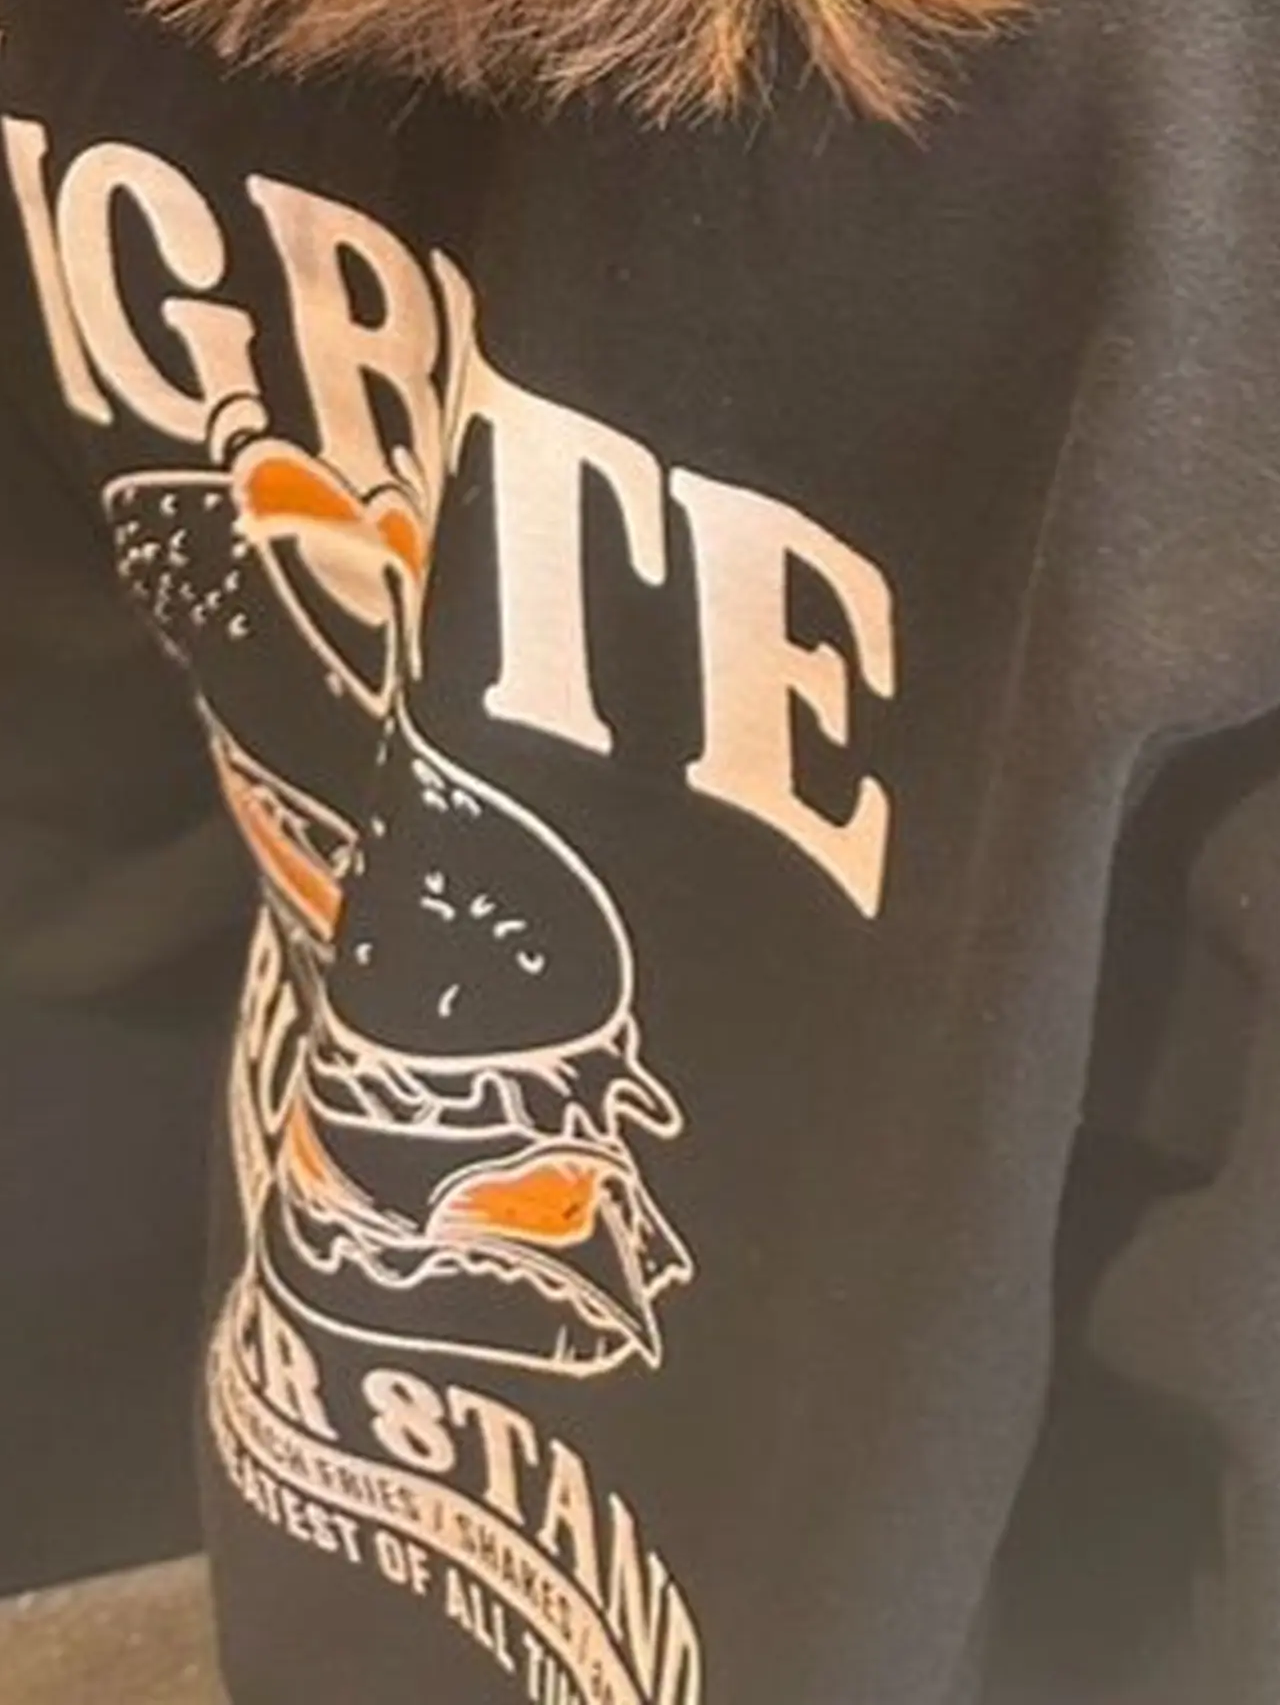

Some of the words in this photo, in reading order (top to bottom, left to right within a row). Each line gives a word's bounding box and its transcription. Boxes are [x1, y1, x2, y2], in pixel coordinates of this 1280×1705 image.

[374, 1528, 433, 1596] OF
[444, 1566, 516, 1674] ALL
[452, 1511, 573, 1643] SHAKES
